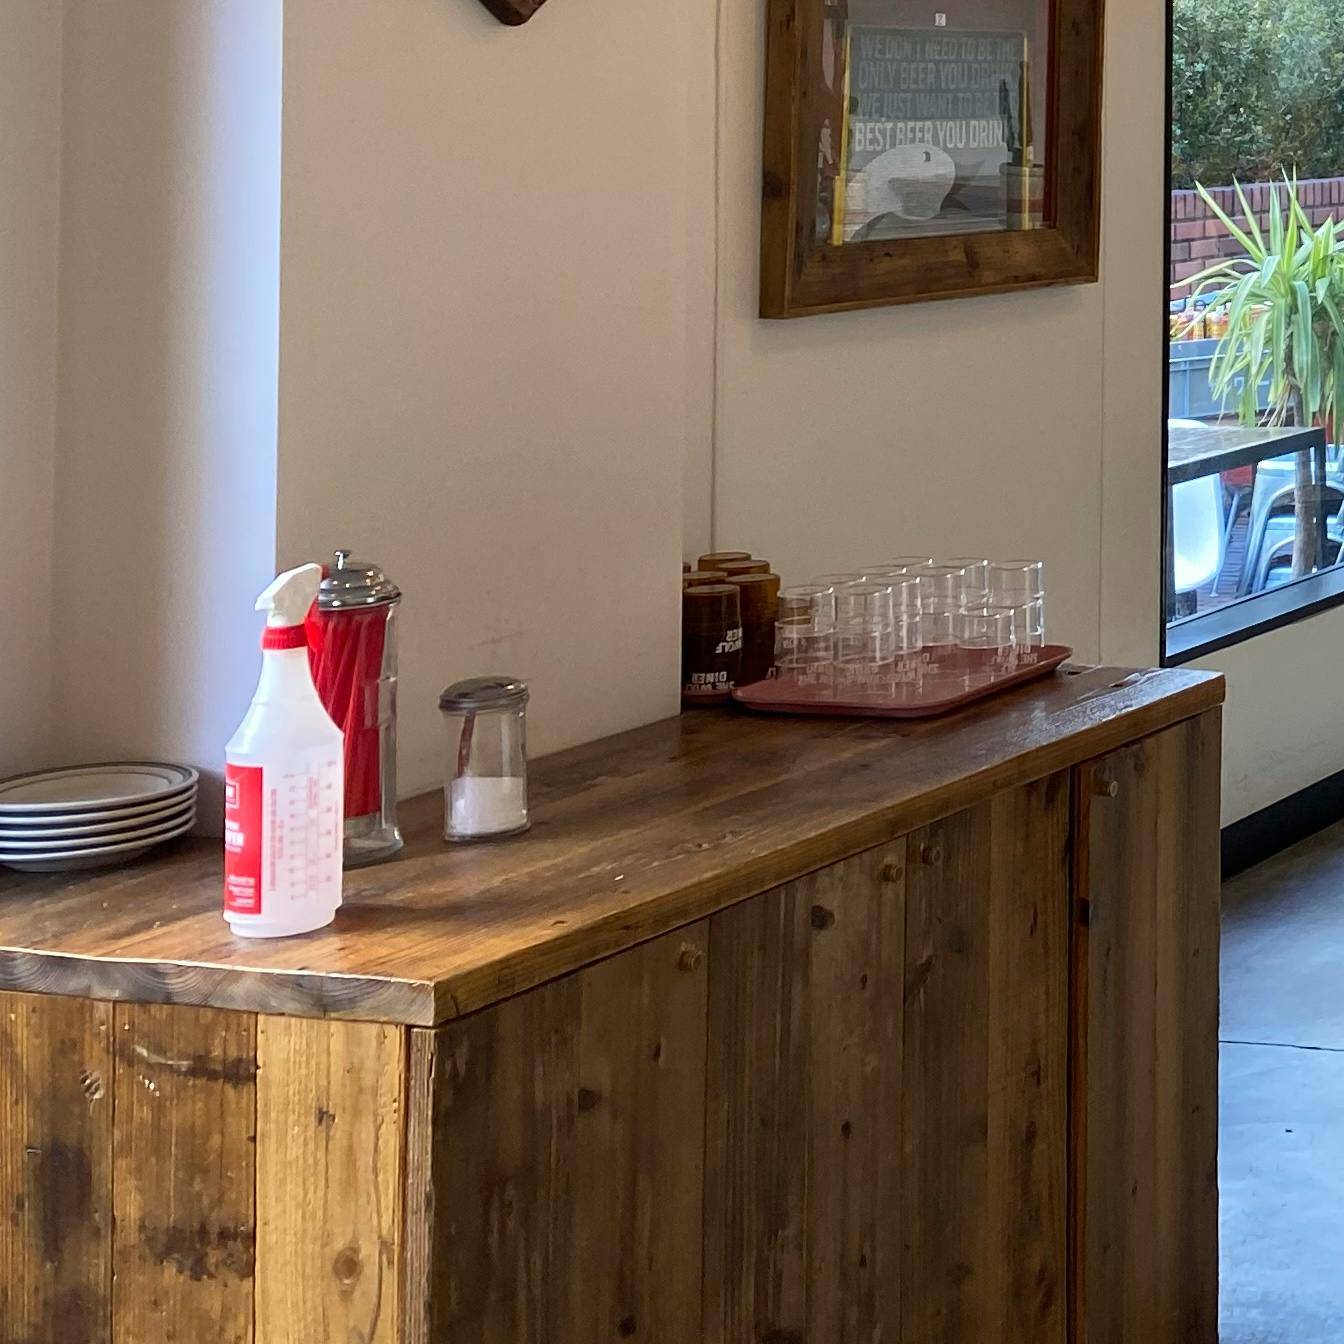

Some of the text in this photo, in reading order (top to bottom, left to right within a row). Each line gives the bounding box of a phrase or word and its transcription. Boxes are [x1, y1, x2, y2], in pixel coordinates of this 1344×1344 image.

[859, 60, 898, 90] ONLY
[901, 61, 936, 90] BEER
[938, 62, 968, 90] YOU
[854, 120, 1008, 152] BEST BEER YOU DRIN
